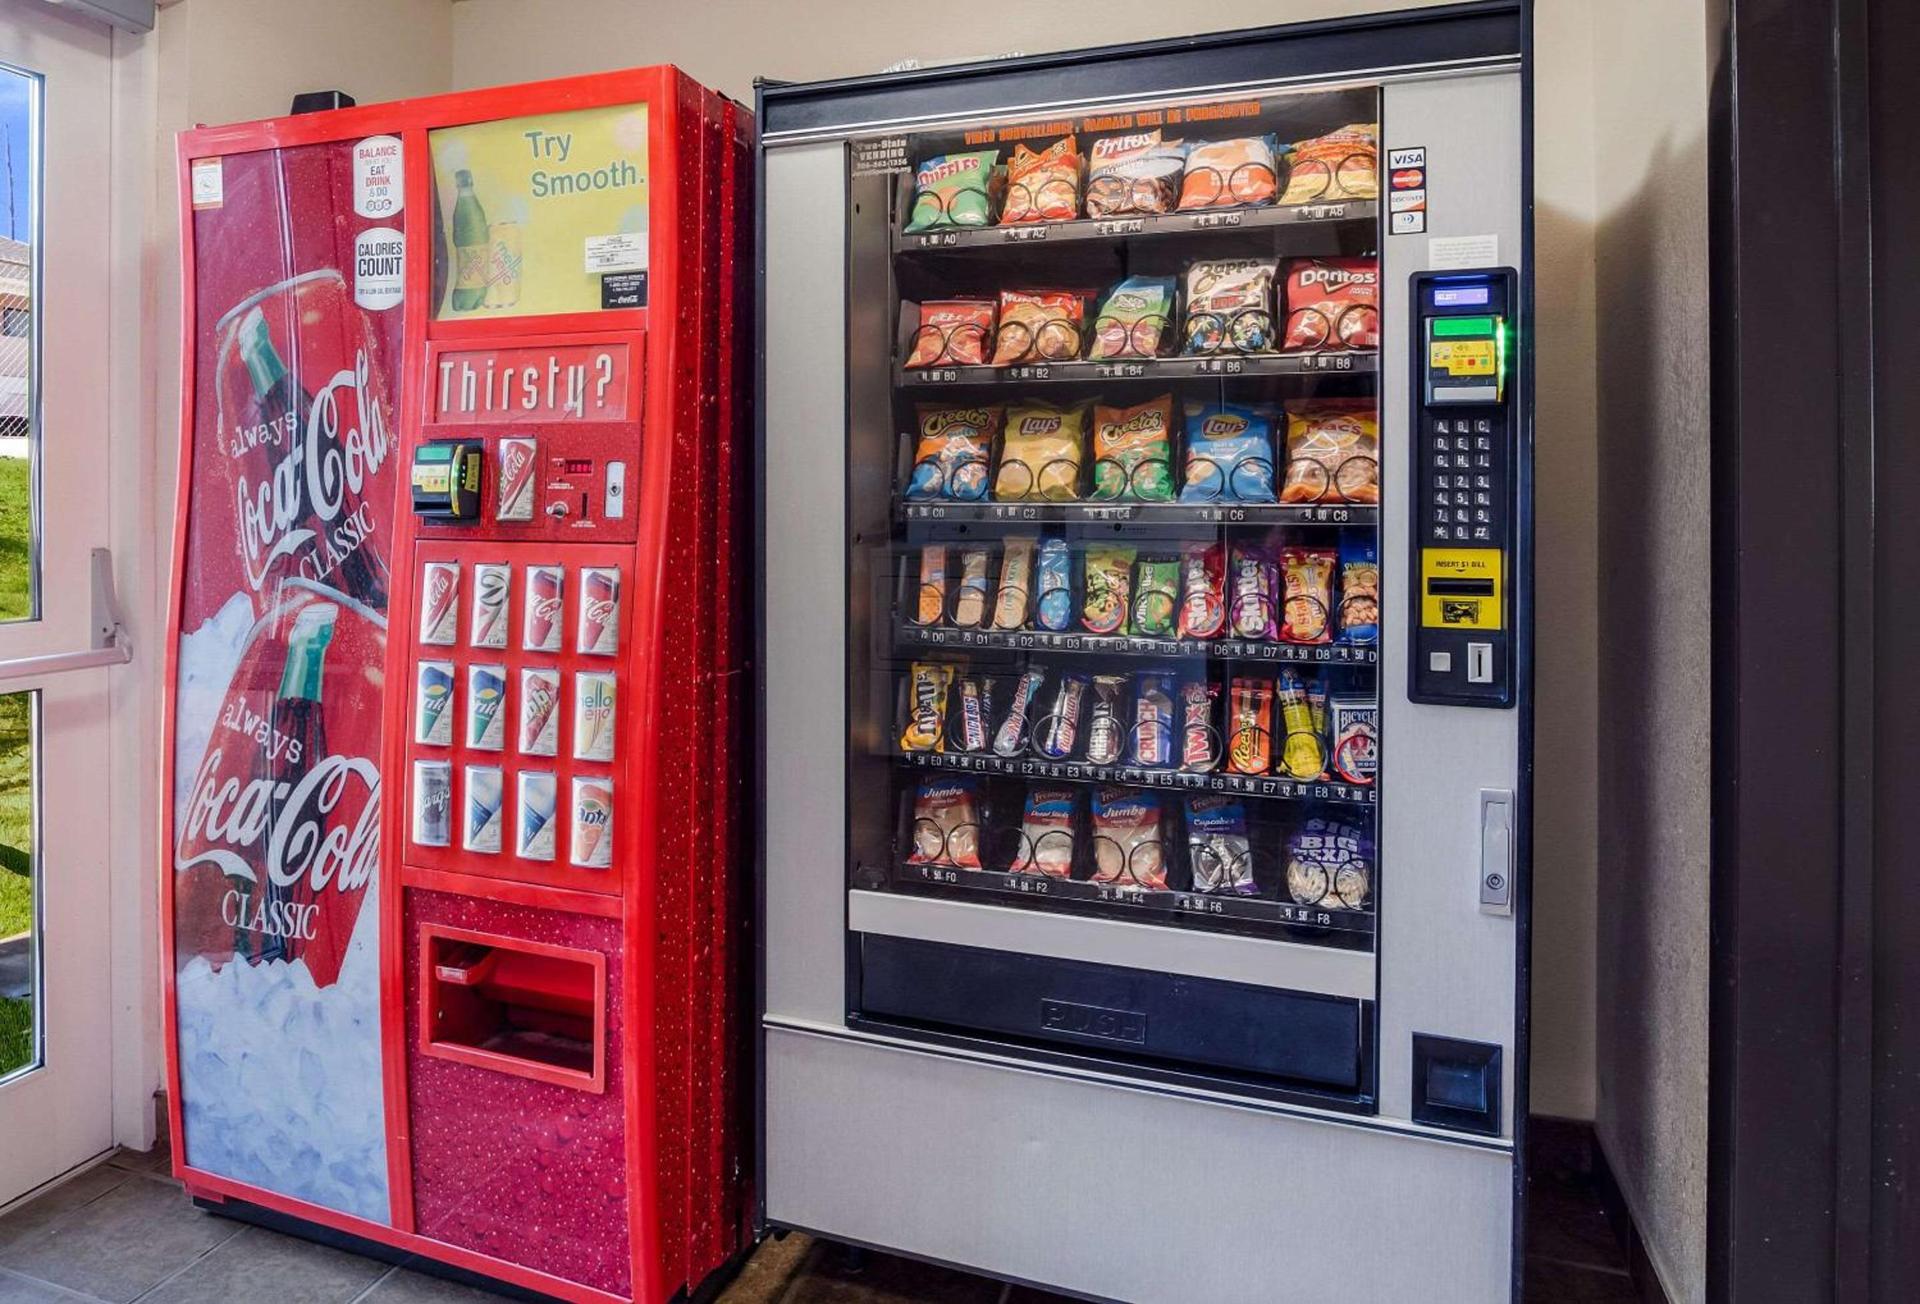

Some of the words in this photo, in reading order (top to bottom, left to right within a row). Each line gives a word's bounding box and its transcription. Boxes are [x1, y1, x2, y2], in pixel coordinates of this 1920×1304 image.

[525, 131, 571, 161] Try
[359, 145, 397, 159] BALANCE
[1394, 153, 1423, 164] VISA
[371, 165, 385, 175] EAT
[366, 176, 391, 187] DRINK
[532, 160, 645, 197] Smooth.
[358, 242, 403, 256] CALORIES
[358, 257, 402, 276] COUNT
[1300, 269, 1377, 287] Doritos
[440, 353, 612, 417] Thirsty?
[922, 409, 990, 438] Cheetos
[1022, 416, 1060, 434] Lay's
[1101, 411, 1163, 441] Cheetos
[1205, 418, 1248, 435] Lay's
[1437, 422, 1445, 431] A
[1458, 421, 1464, 431] B
[1478, 421, 1485, 431] C
[230, 411, 298, 458] always
[1438, 439, 1444, 448] D
[1457, 438, 1463, 448] E
[1478, 438, 1484, 448] F
[1437, 455, 1444, 465] G
[1457, 455, 1464, 465] H
[1438, 476, 1445, 486] 1
[1457, 476, 1463, 486] 2
[1478, 476, 1484, 486] 3
[1437, 493, 1443, 503] 4
[1457, 493, 1463, 502] 5
[1478, 493, 1484, 503] 6
[1023, 509, 1035, 519] C2
[1230, 510, 1243, 520] C6
[1334, 510, 1347, 521] C8
[1437, 509, 1443, 519] 7
[1457, 509, 1463, 519] 8
[1478, 510, 1484, 520] 9
[299, 501, 375, 581] CLASSIC
[1436, 561, 1459, 569] INSERT
[1238, 560, 1263, 631] Skittles
[932, 633, 945, 642] D0
[977, 635, 988, 644] D1
[1021, 637, 1033, 647] D2
[1067, 639, 1080, 649] D3
[1214, 645, 1228, 656] D6
[1263, 647, 1277, 657] D7
[1316, 650, 1330, 660] D8
[964, 696, 980, 746] SNICKERS
[1341, 710, 1377, 733] BICYCLE
[222, 697, 302, 763] always
[1139, 701, 1156, 760] CRUNCH
[975, 760, 986, 769] E1
[1022, 764, 1033, 774] E2
[1067, 767, 1079, 777] E3
[1115, 771, 1127, 781] E4
[1160, 775, 1173, 785] E5
[1211, 778, 1224, 789] E6
[924, 788, 963, 799] Jumbo
[1263, 783, 1276, 793] E7
[1315, 787, 1328, 797] E8
[1103, 805, 1147, 819] Jumbo
[175, 748, 381, 892] Coca-Cola
[1301, 836, 1358, 852] BIG
[946, 873, 956, 883] F0
[1036, 883, 1048, 893] F2
[1210, 902, 1222, 913] F6
[222, 890, 320, 940] CLASSIC
[1317, 914, 1330, 924] F8
